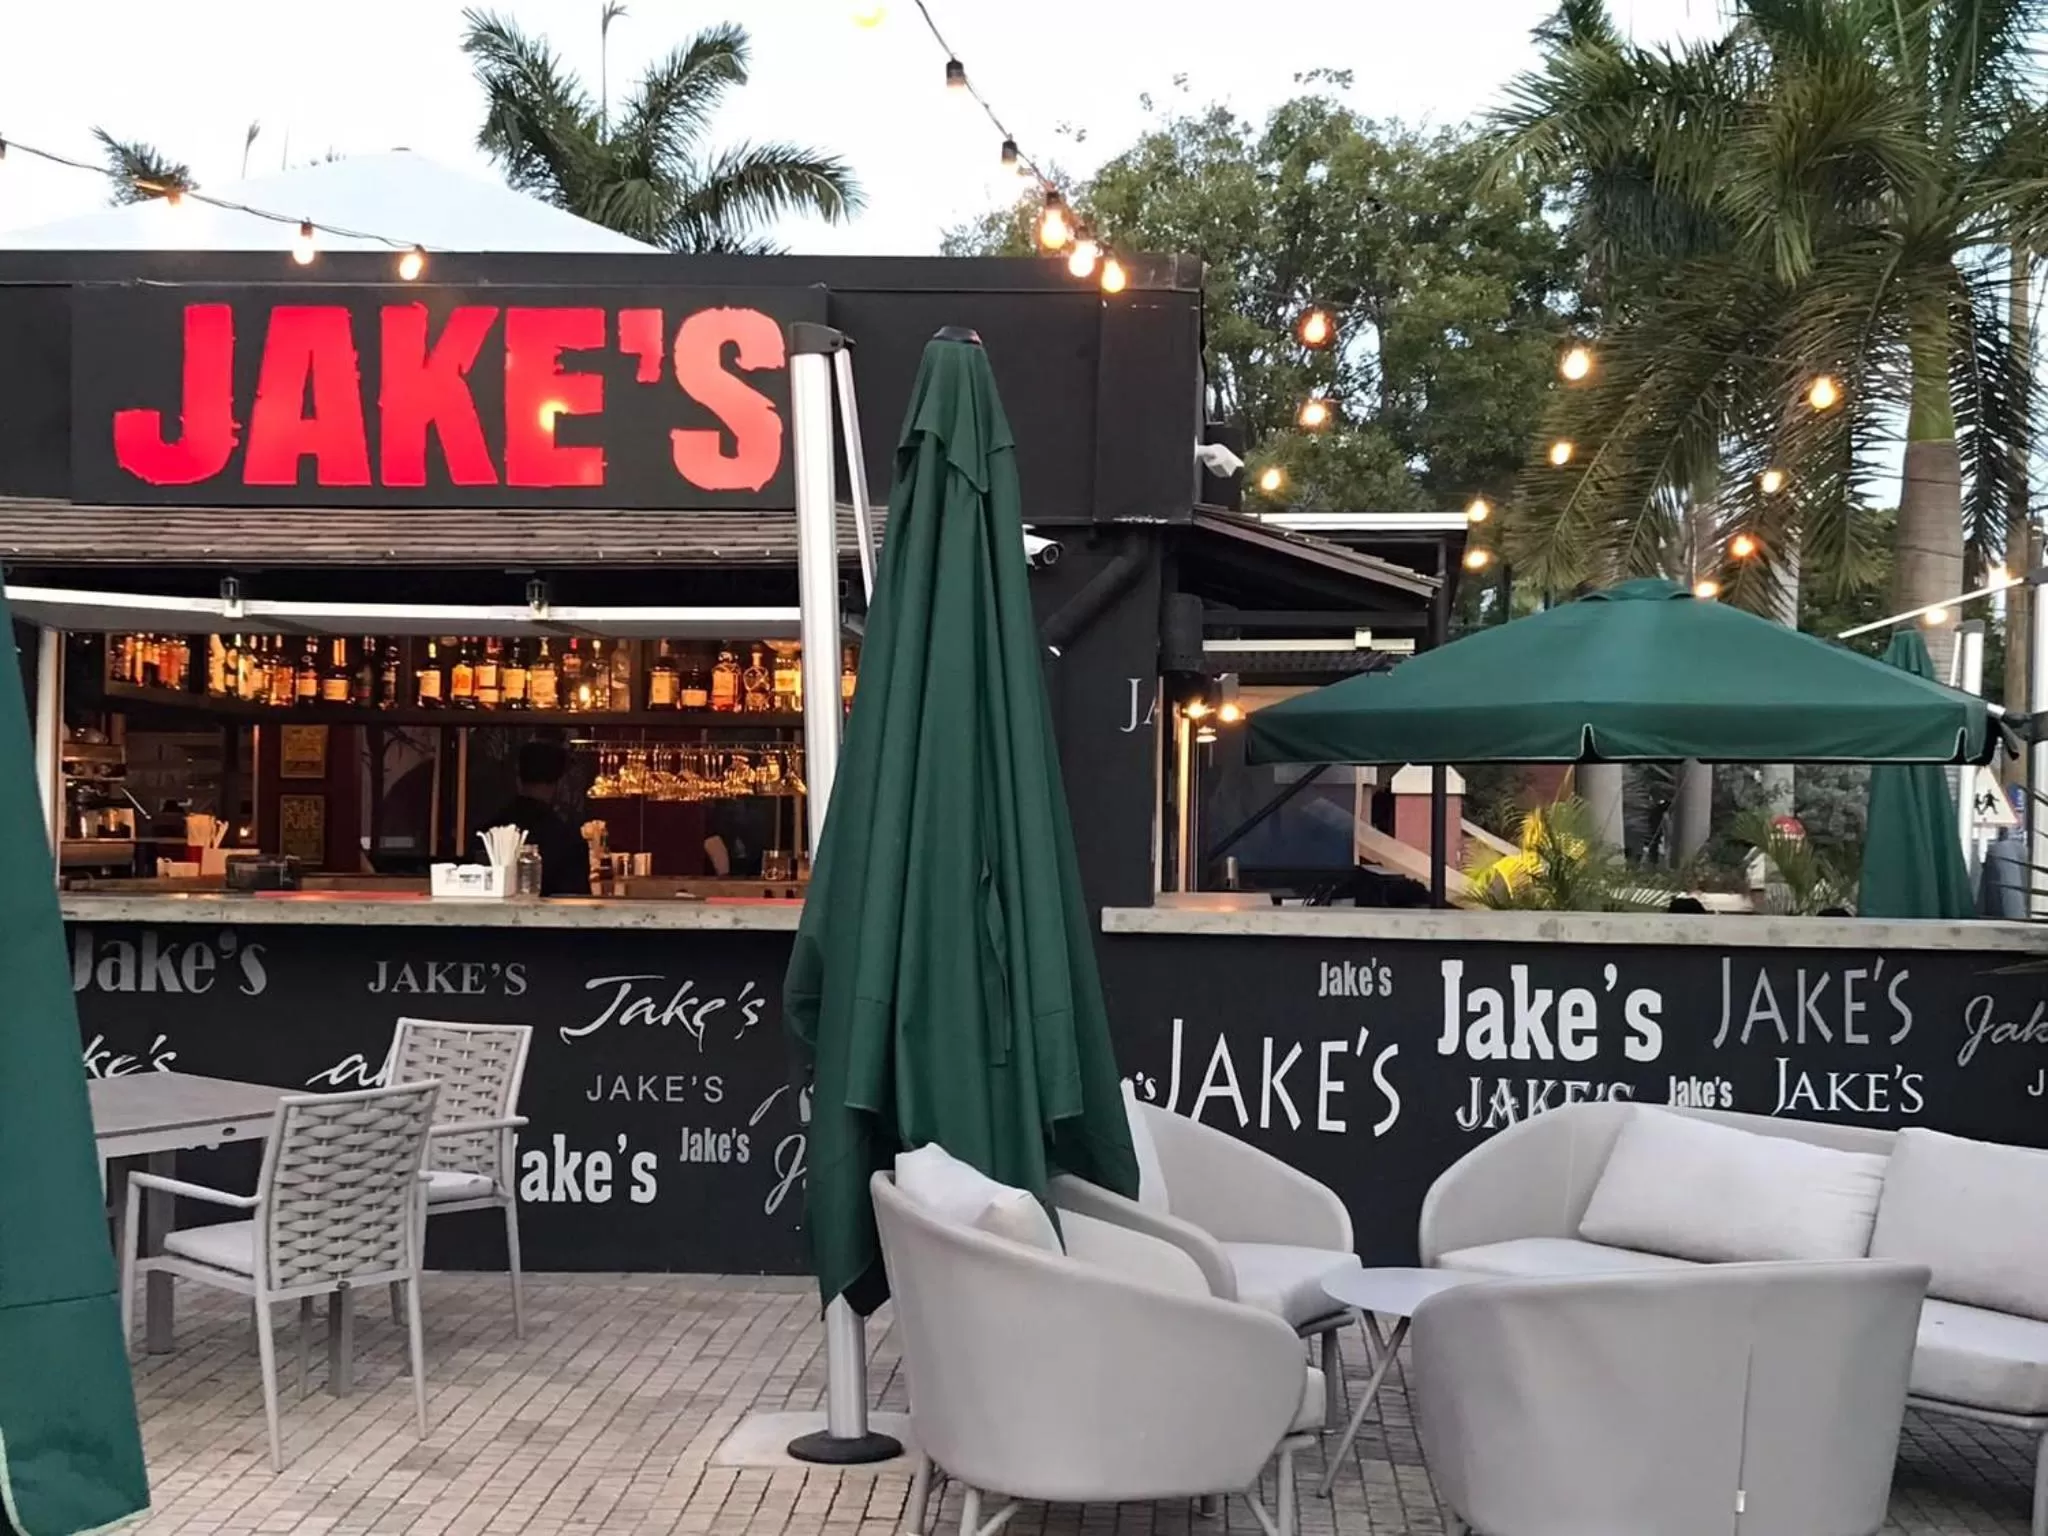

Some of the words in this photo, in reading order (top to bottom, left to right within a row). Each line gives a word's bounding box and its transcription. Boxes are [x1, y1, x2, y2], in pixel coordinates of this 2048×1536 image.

[114, 302, 784, 493] JAKE'S
[73, 928, 268, 996] Jake's
[367, 960, 527, 996] JAKE'S
[1318, 957, 1393, 998] Jake's
[560, 975, 765, 1053] Jake's
[1437, 959, 1663, 1062] Jake's
[1713, 957, 1914, 1049] JAKE'S
[586, 1074, 724, 1103] JAKE'S
[1165, 1018, 1400, 1137] JAKE'S
[1669, 1075, 1733, 1108] Jake's
[1765, 1057, 1924, 1114] JAKE'S
[515, 1133, 658, 1204] ake's
[680, 1127, 750, 1164] Jake's
